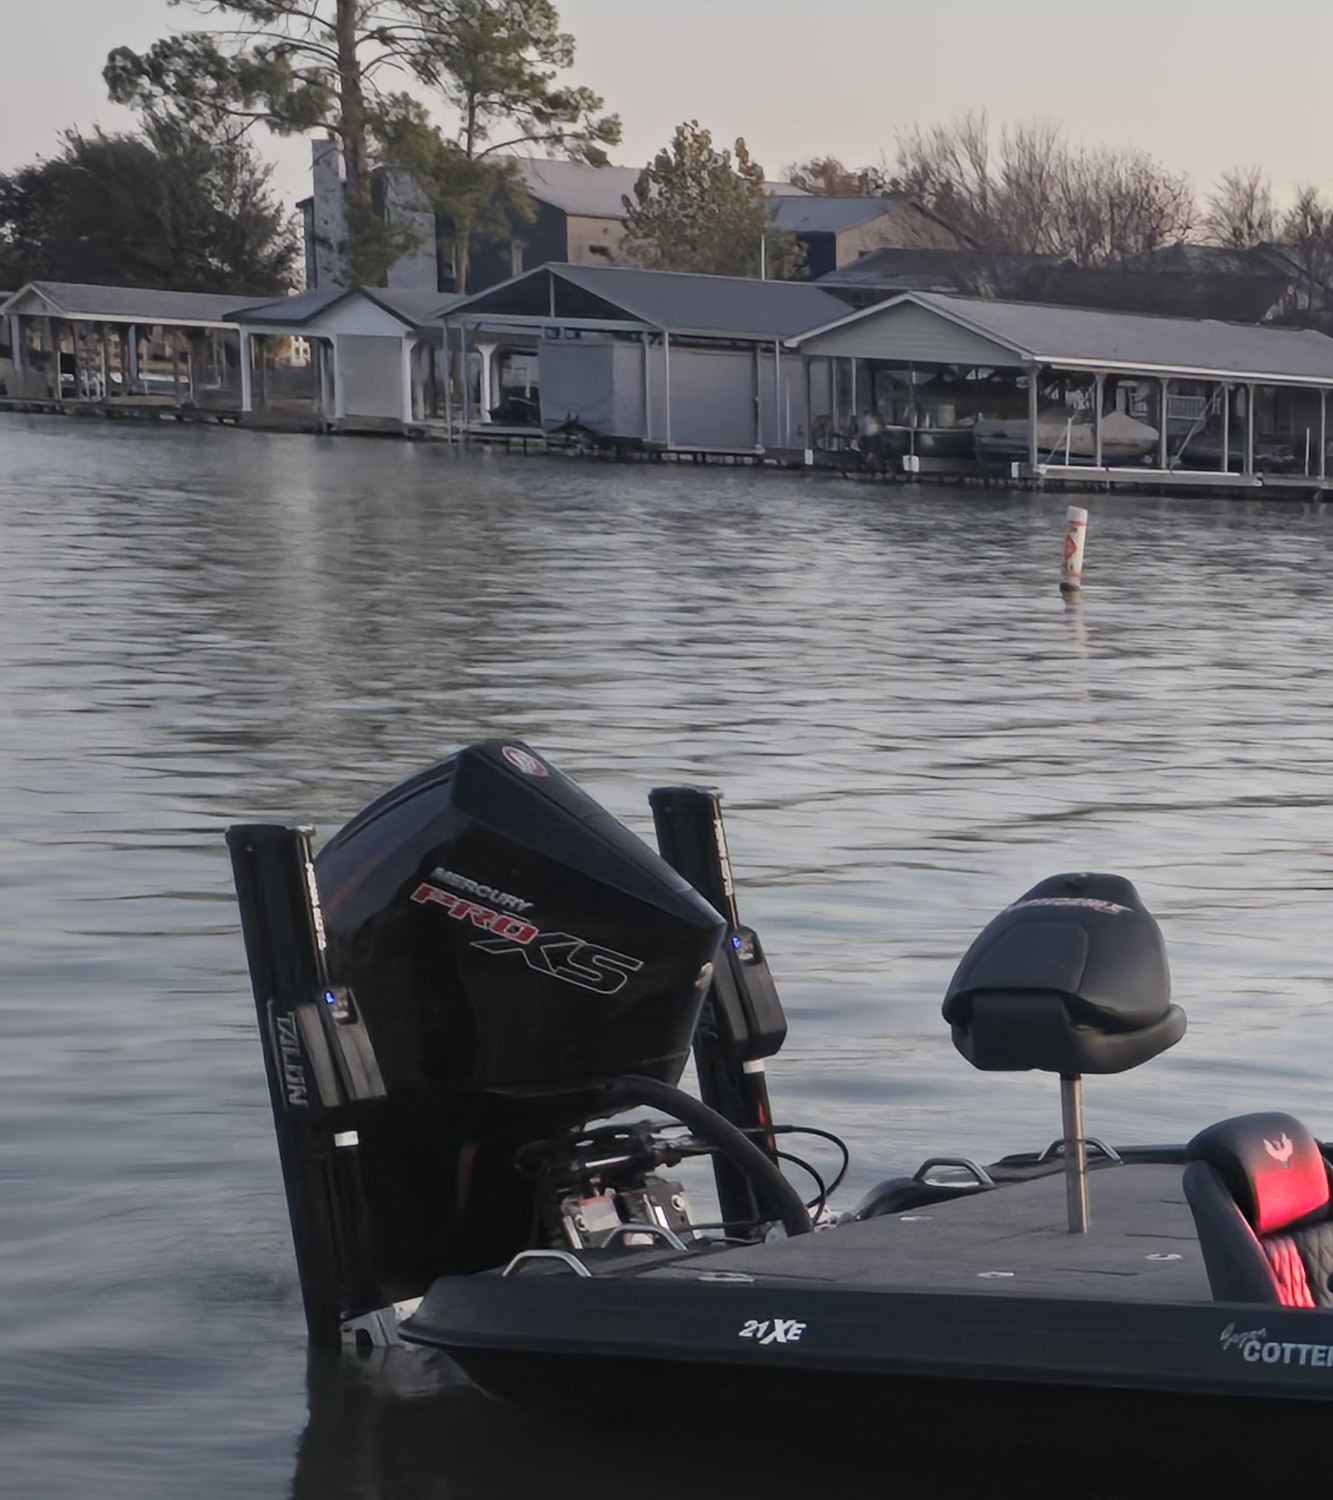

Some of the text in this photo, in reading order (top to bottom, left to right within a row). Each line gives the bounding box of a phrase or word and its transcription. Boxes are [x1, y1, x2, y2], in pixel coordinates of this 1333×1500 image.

[430, 867, 534, 912] MERCURY
[410, 883, 643, 994] PRO XS
[276, 1010, 309, 1107] TALON
[738, 1319, 807, 1345] 21XE
